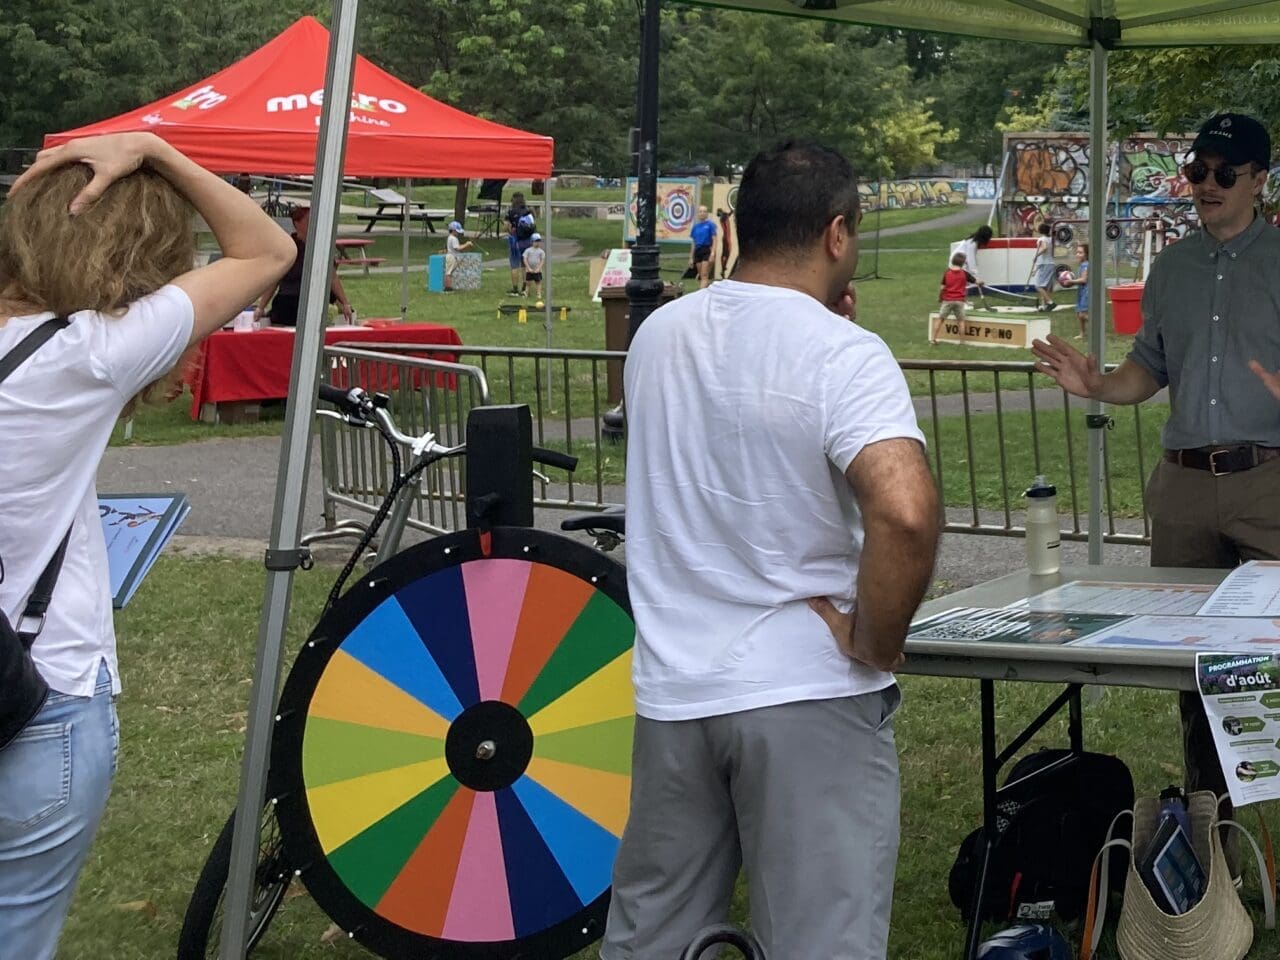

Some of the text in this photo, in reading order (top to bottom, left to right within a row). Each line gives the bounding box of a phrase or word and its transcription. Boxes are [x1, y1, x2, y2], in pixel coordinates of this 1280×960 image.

[266, 88, 407, 114] mero
[945, 324, 981, 337] VOLEY
[1208, 655, 1270, 673] PROGRAMMATION
[1226, 672, 1272, 687] d'août
